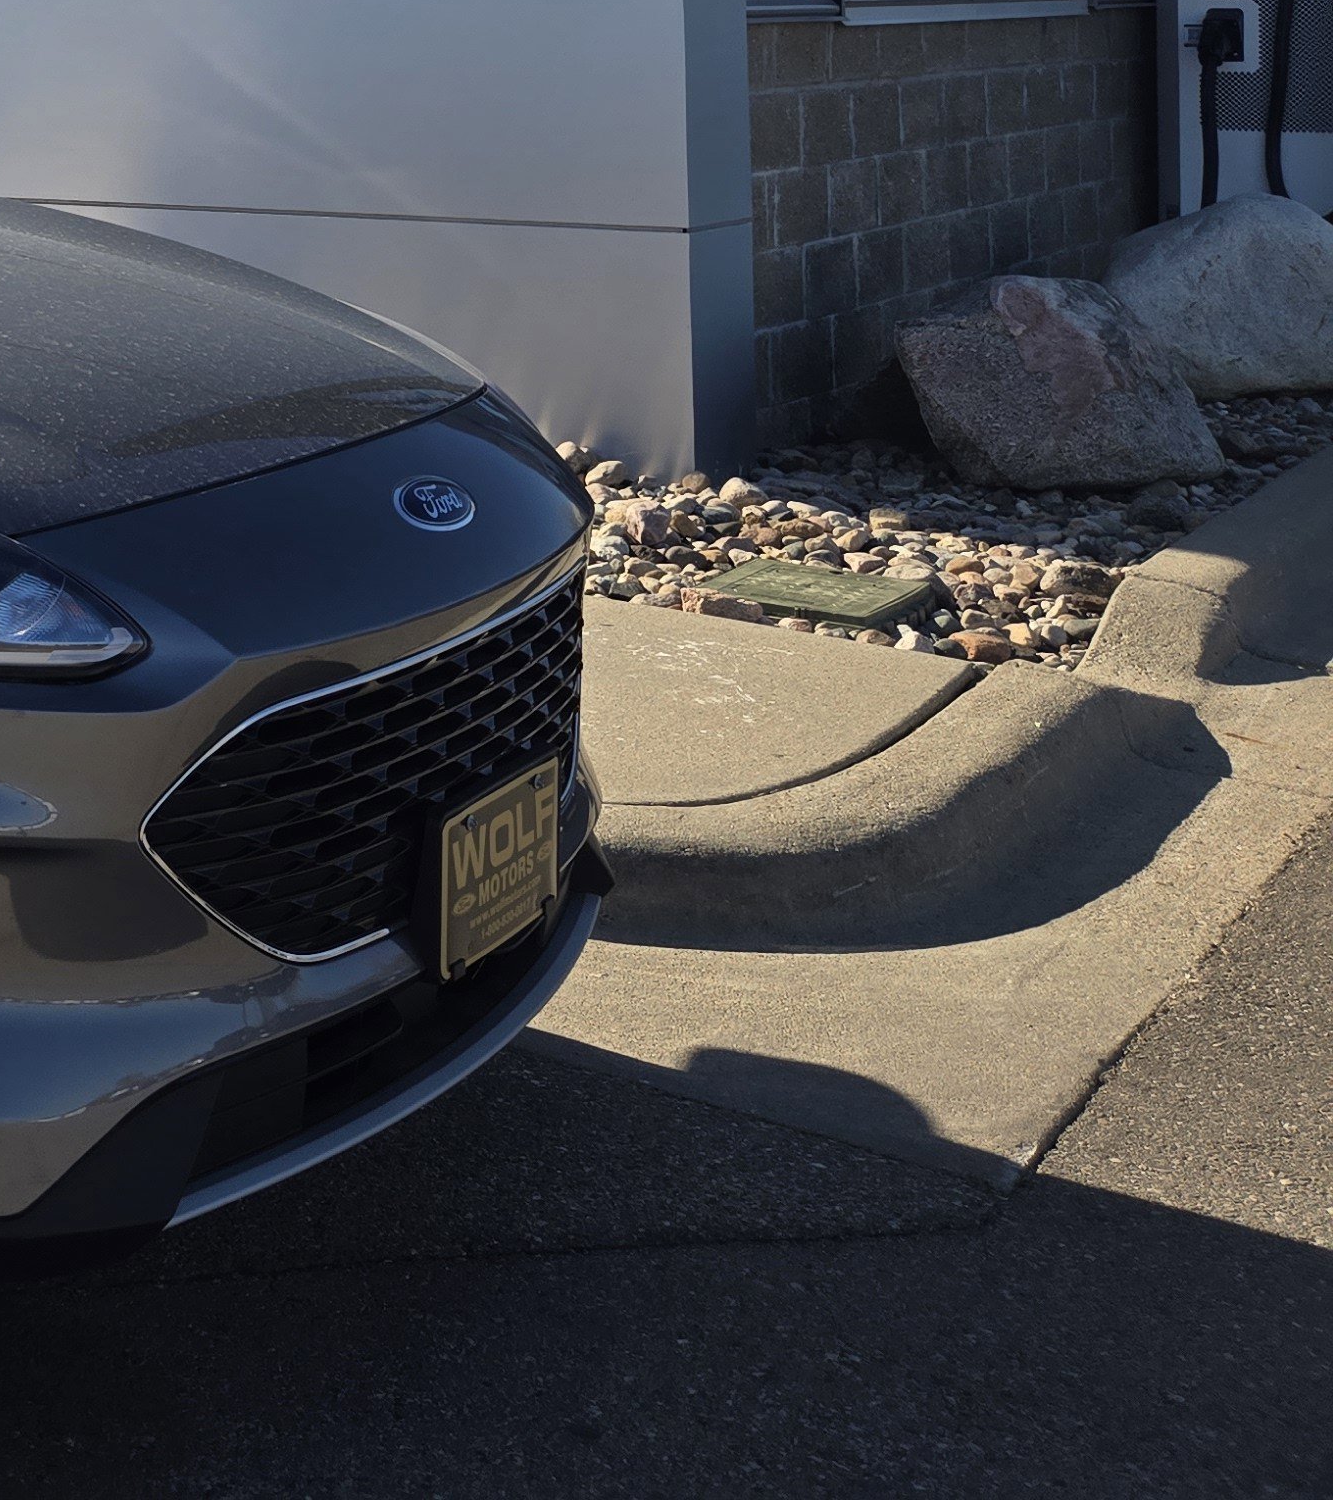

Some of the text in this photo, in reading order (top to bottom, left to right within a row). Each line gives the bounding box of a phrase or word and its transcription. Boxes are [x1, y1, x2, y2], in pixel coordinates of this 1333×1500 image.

[414, 484, 463, 518] Ford
[452, 783, 554, 890] WOLF
[478, 850, 534, 907] MOTORS
